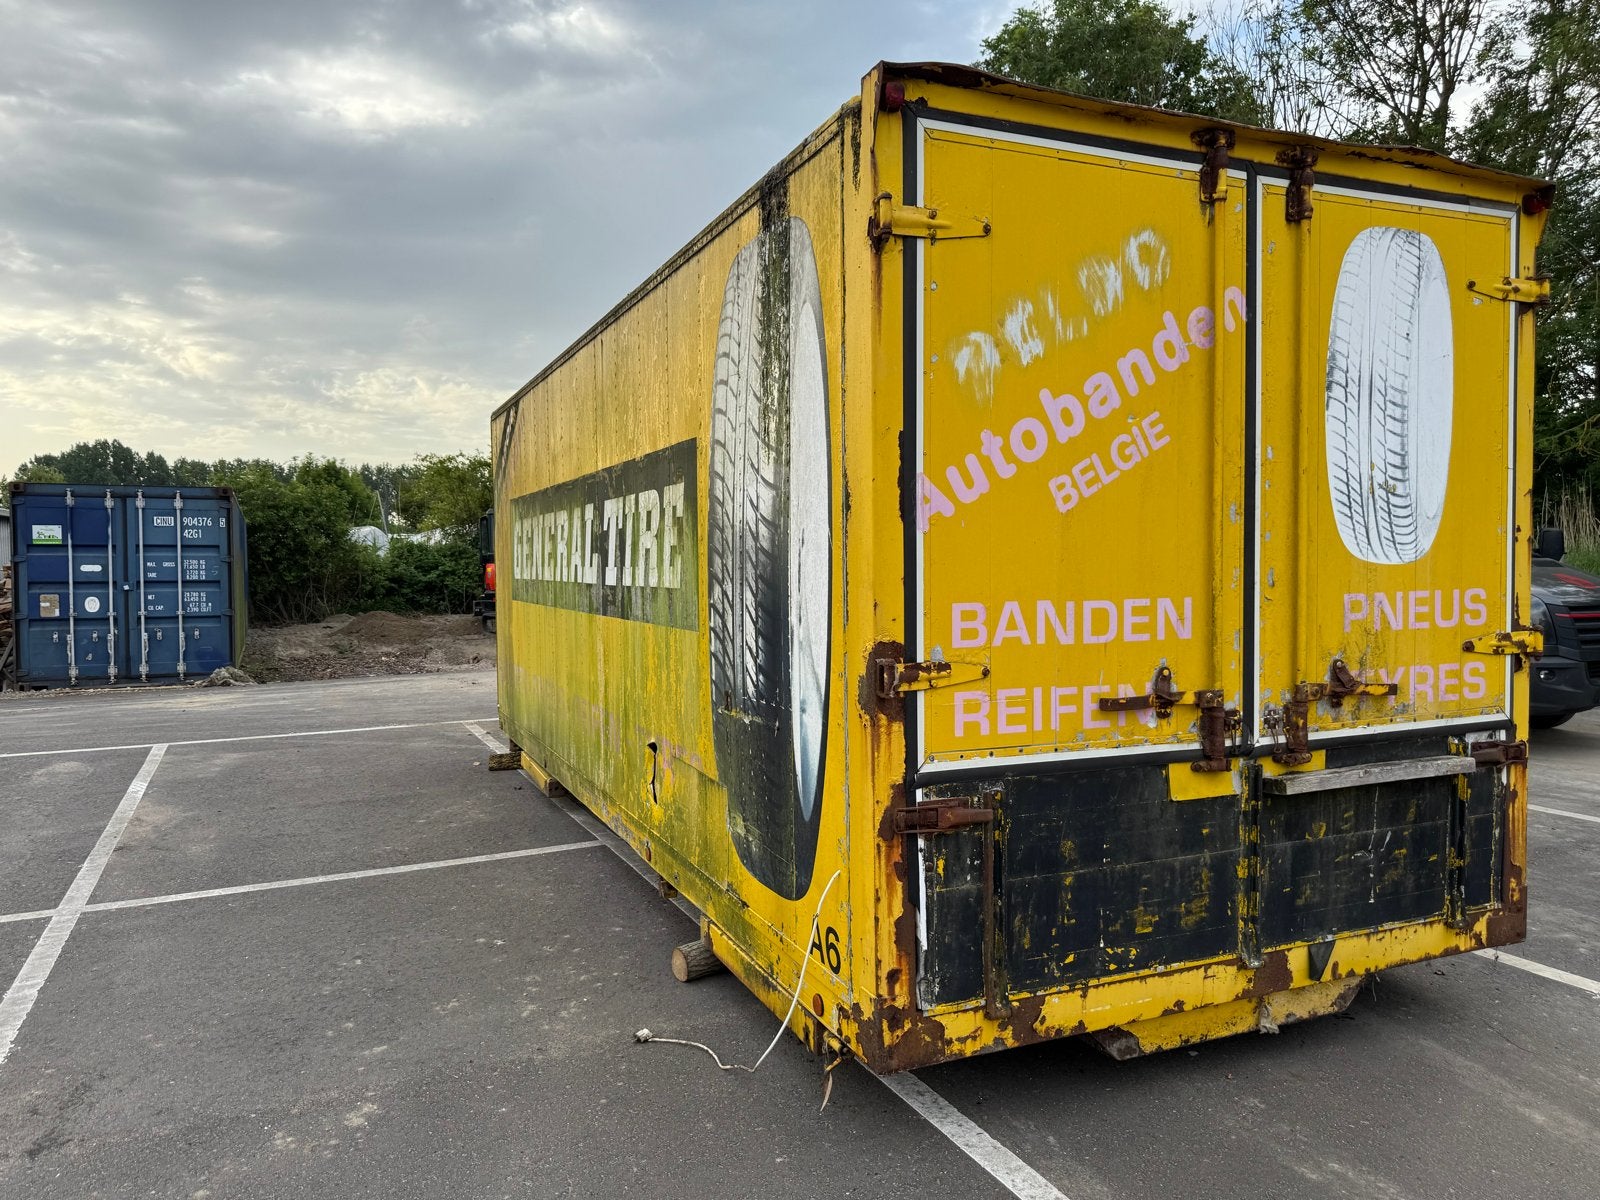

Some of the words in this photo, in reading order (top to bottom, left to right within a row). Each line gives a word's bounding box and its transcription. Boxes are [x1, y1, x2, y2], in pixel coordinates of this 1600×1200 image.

[916, 286, 1248, 533] Autobanden
[1048, 411, 1171, 514] BELGIE
[183, 517, 212, 526] 904376
[183, 529, 202, 538] 42G1
[514, 503, 598, 584] GENERAL
[603, 482, 685, 588] TIRE
[951, 596, 1193, 649] BANDEN
[1343, 588, 1488, 633] PNEUS
[806, 914, 842, 976] A6
